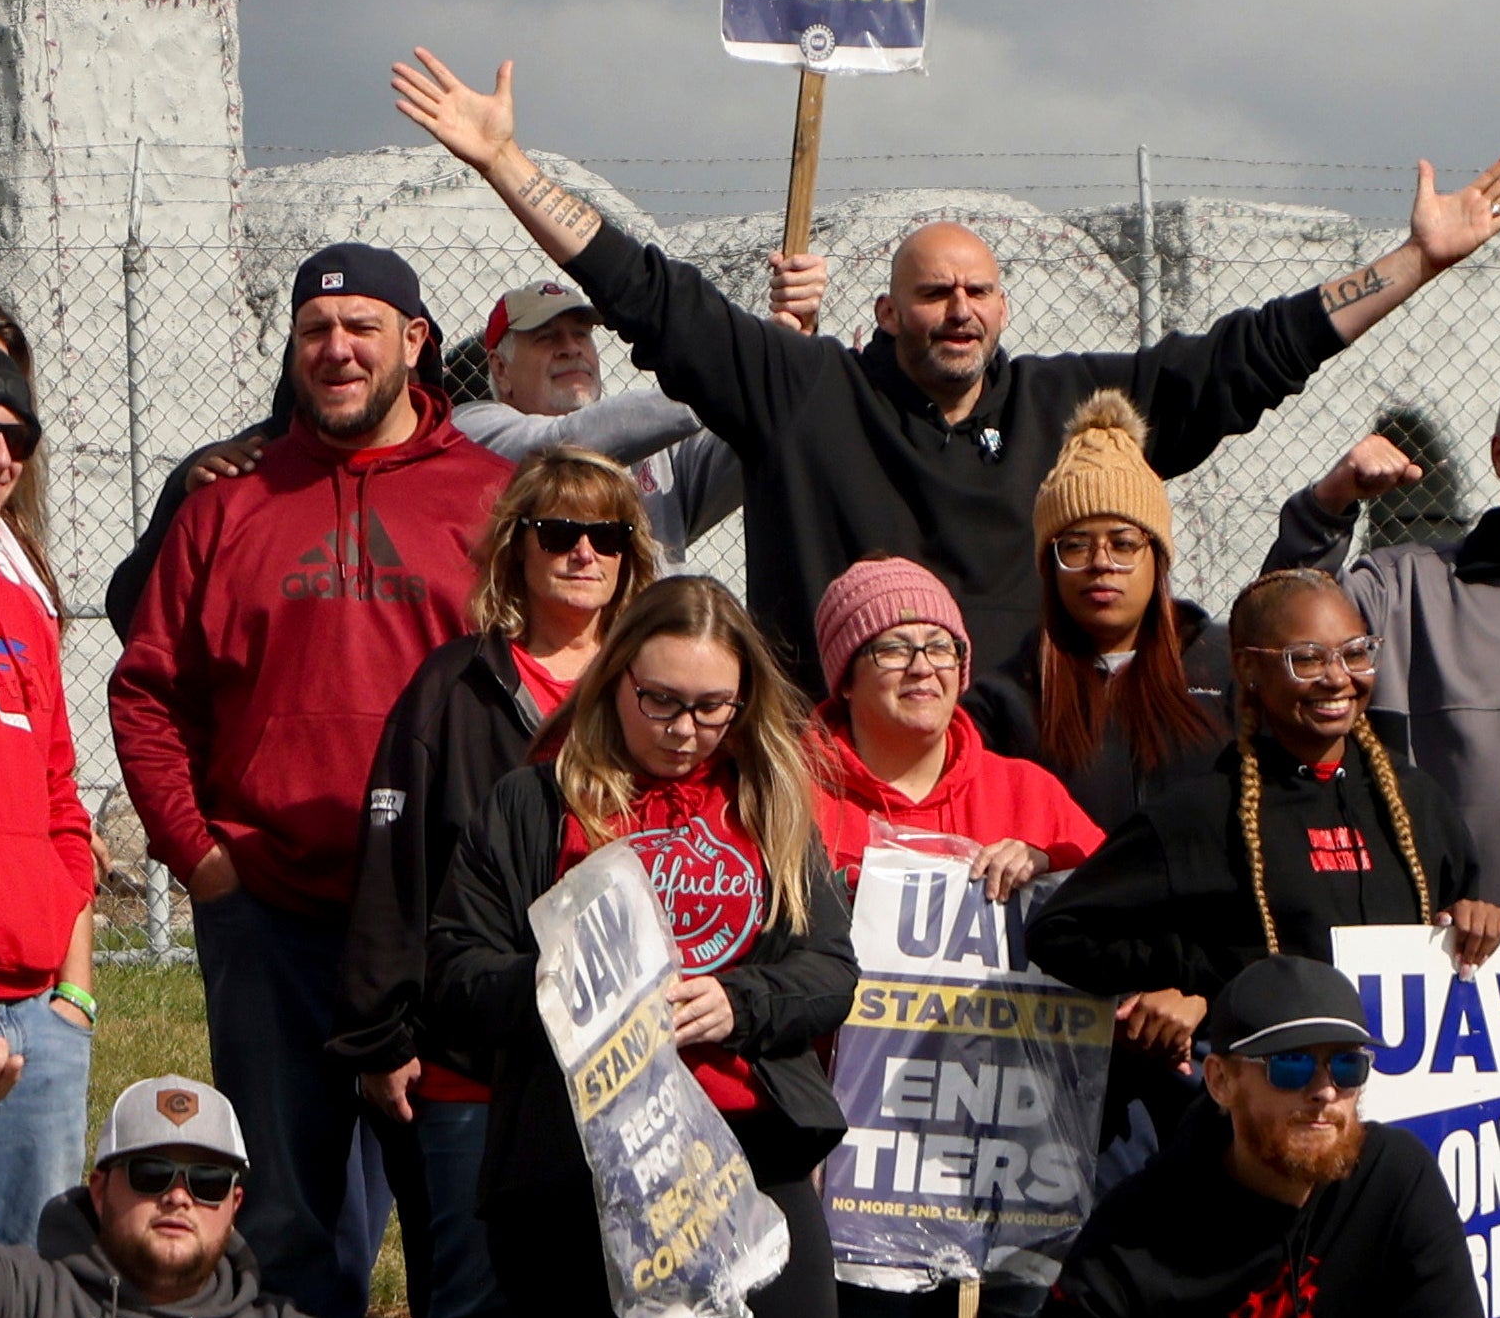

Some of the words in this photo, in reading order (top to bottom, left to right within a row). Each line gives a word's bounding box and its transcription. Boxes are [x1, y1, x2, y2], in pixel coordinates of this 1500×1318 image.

[1322, 266, 1382, 313] 104
[281, 563, 428, 603] adidas
[571, 886, 643, 1027] UAW
[689, 923, 735, 963] TODAY
[858, 988, 1017, 1029] STAND
[1034, 1004, 1096, 1038] UP
[584, 1019, 650, 1103] STAND
[880, 1057, 1055, 1128] END
[841, 1128, 1082, 1203] TIERS
[832, 1198, 856, 1211] NO
[859, 1200, 905, 1216] MORE
[907, 1204, 941, 1219] 2ND
[1001, 1211, 1081, 1226] WORKERS
